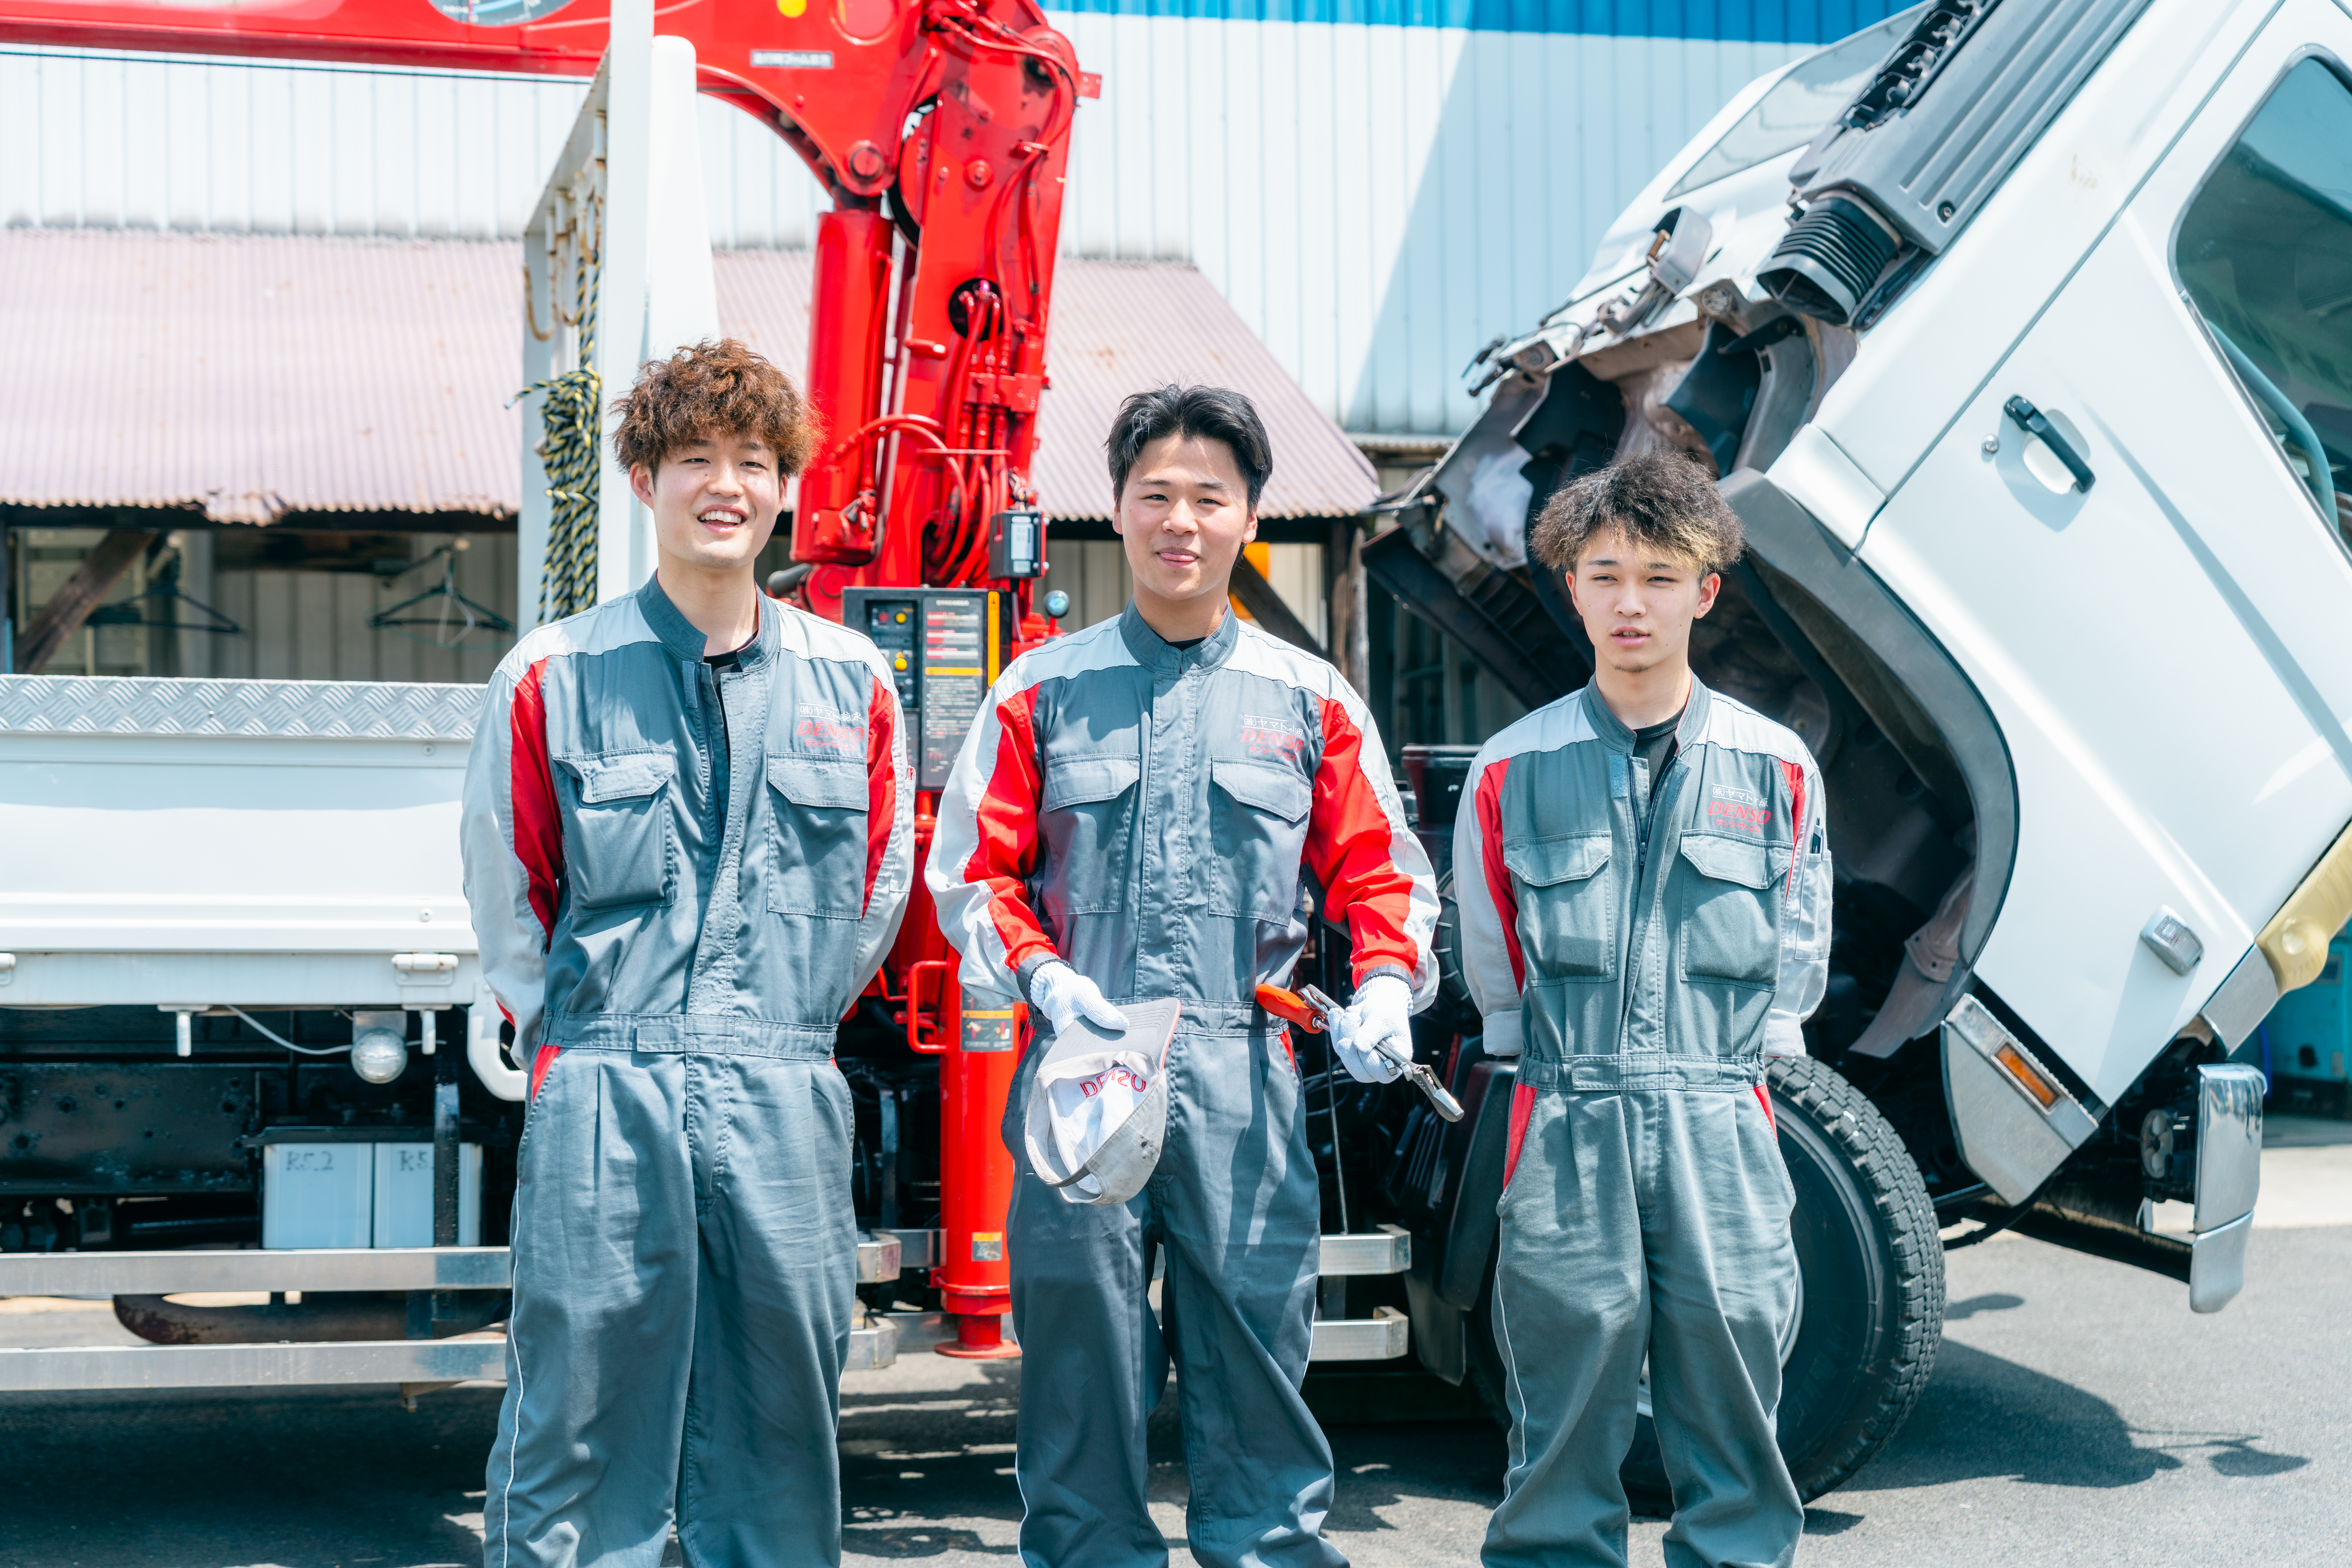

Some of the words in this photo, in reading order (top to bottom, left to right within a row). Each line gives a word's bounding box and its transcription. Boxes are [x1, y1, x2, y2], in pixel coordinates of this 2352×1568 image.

[796, 721, 865, 741] DENSO
[805, 739, 856, 751] デンソーサービス
[1240, 729, 1303, 753] DENSO
[1249, 745, 1296, 762] デンソーサービス
[1708, 801, 1771, 824] DENSO
[1716, 819, 1760, 834] デンソーサービス
